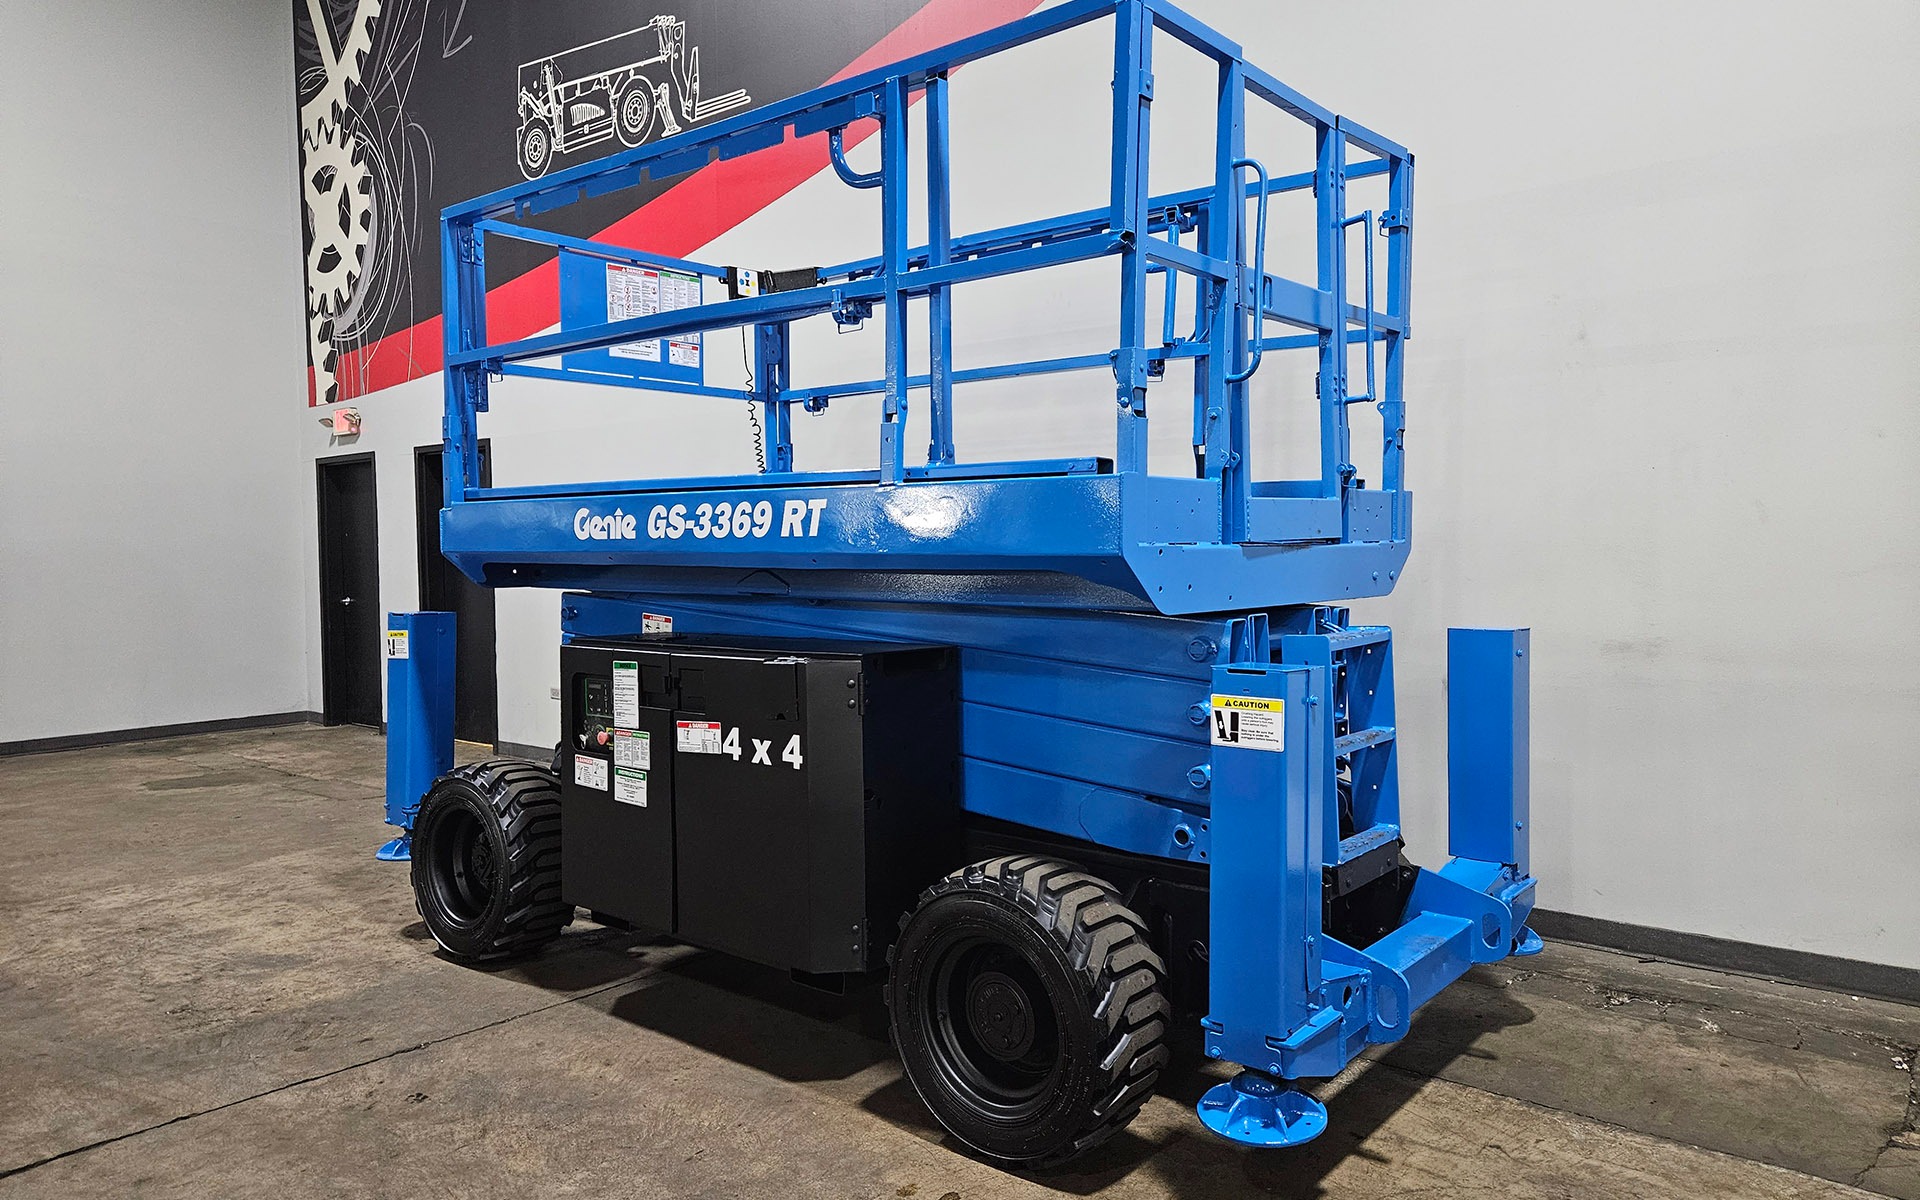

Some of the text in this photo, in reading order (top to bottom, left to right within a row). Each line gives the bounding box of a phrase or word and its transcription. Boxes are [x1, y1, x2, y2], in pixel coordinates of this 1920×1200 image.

[573, 498, 828, 540] Genie GS-3369 RT
[1233, 700, 1269, 709] CAUTION
[722, 727, 742, 761] 4
[751, 738, 772, 766] x
[782, 734, 803, 770] 4
